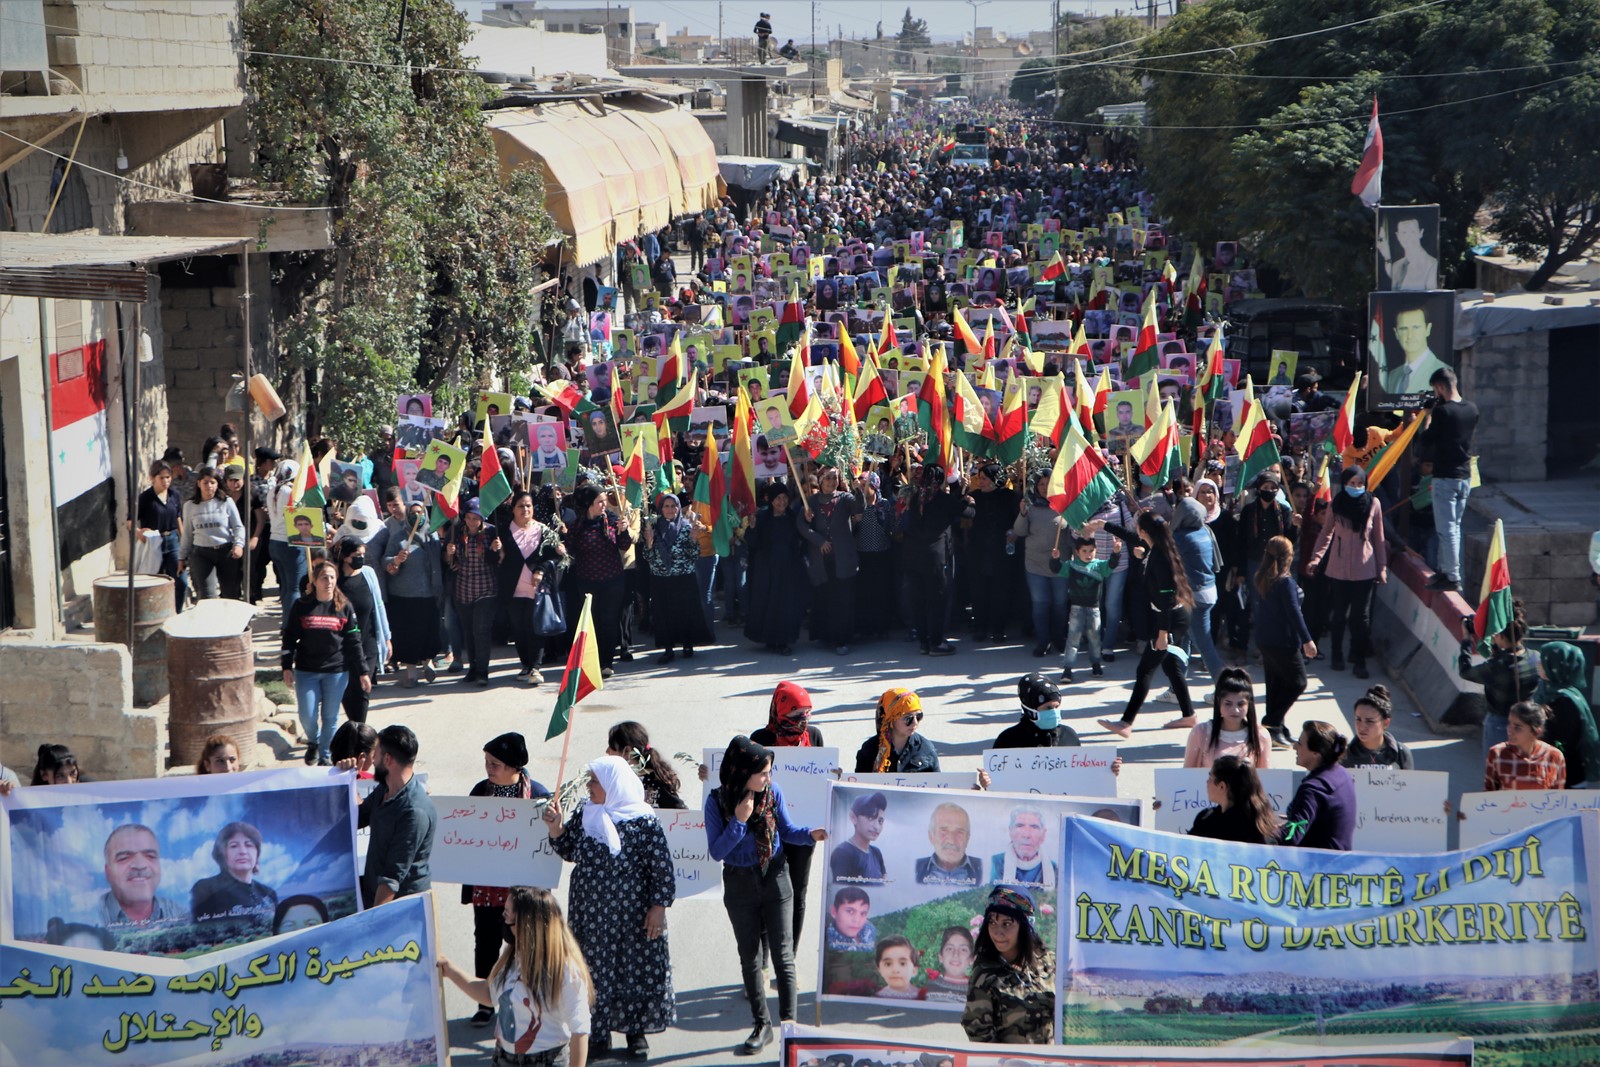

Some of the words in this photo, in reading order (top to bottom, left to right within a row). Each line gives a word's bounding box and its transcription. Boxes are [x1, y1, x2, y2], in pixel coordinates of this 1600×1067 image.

[495, 806, 516, 823] قتل
[1107, 844, 1219, 898] MEŞA
[1228, 859, 1404, 909] RÛMETÊ
[1412, 867, 1450, 901] LI
[1462, 834, 1544, 885] DIJÎ
[1076, 892, 1231, 949] ÎXANET
[1241, 917, 1271, 950] Û
[1281, 892, 1587, 949] DAGIRKERIYÊ
[305, 939, 421, 984] مسيرة
[102, 1003, 263, 1053] والإحتلال
